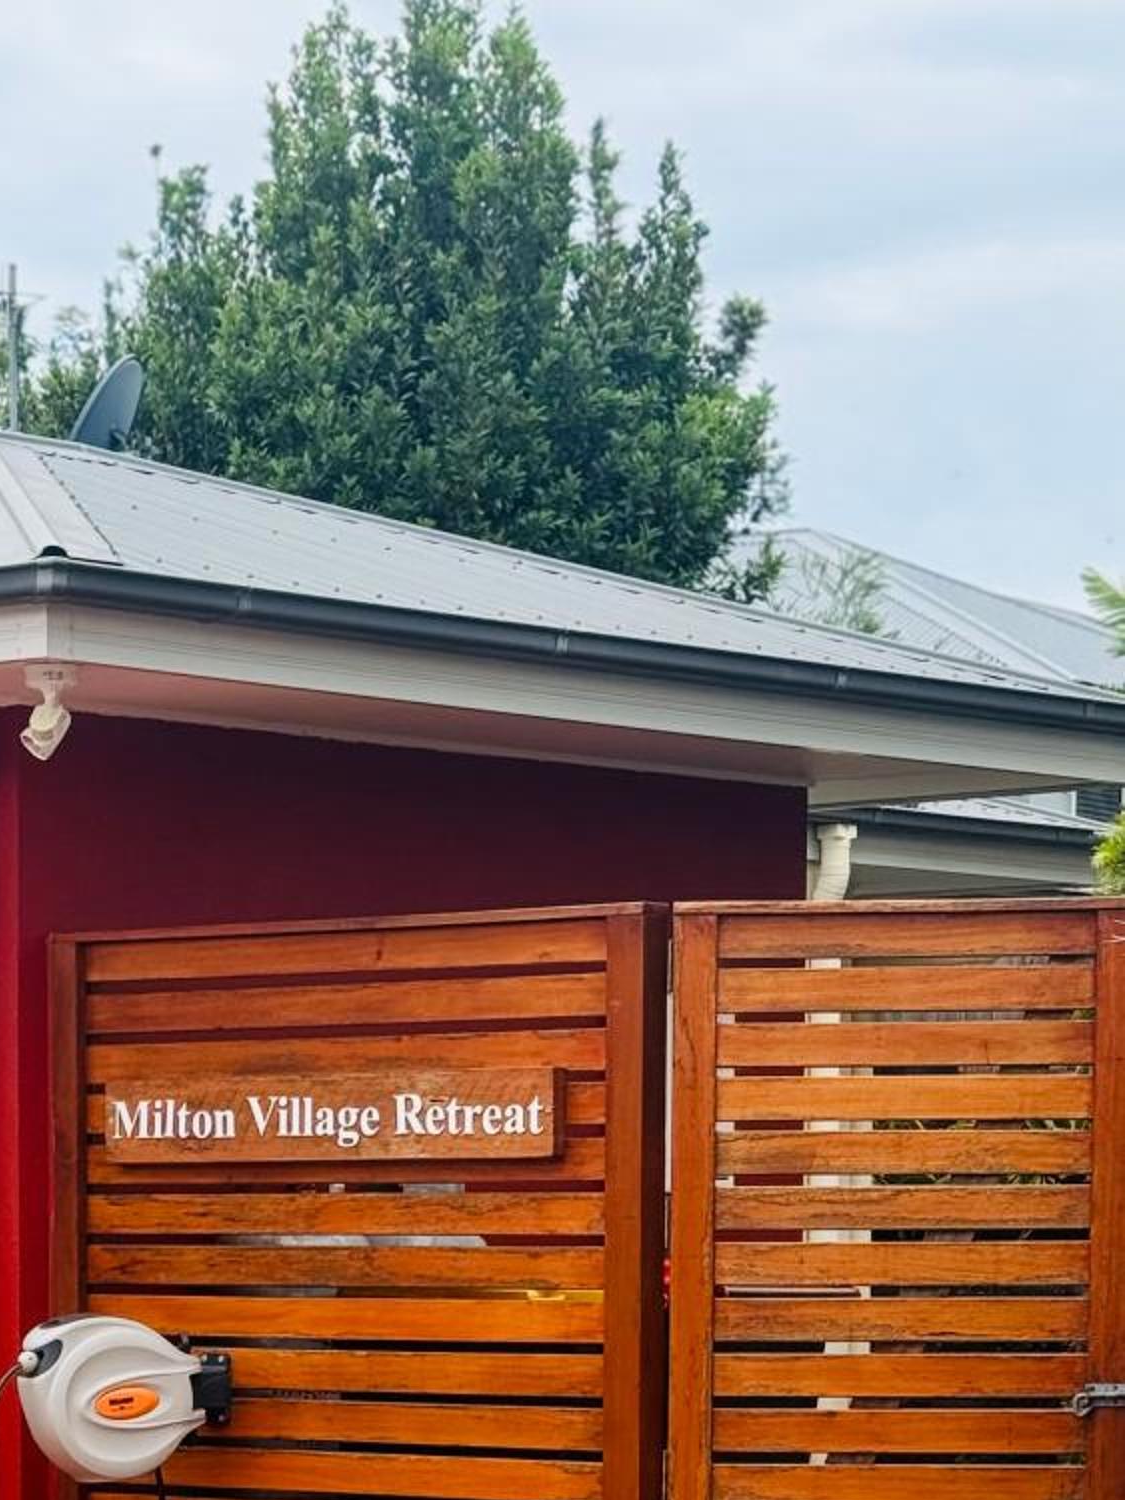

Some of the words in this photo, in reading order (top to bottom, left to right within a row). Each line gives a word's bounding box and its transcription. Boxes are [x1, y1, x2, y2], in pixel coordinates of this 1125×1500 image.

[111, 1099, 236, 1139] Milton
[246, 1096, 380, 1147] Village
[393, 1093, 544, 1136] Retreat
